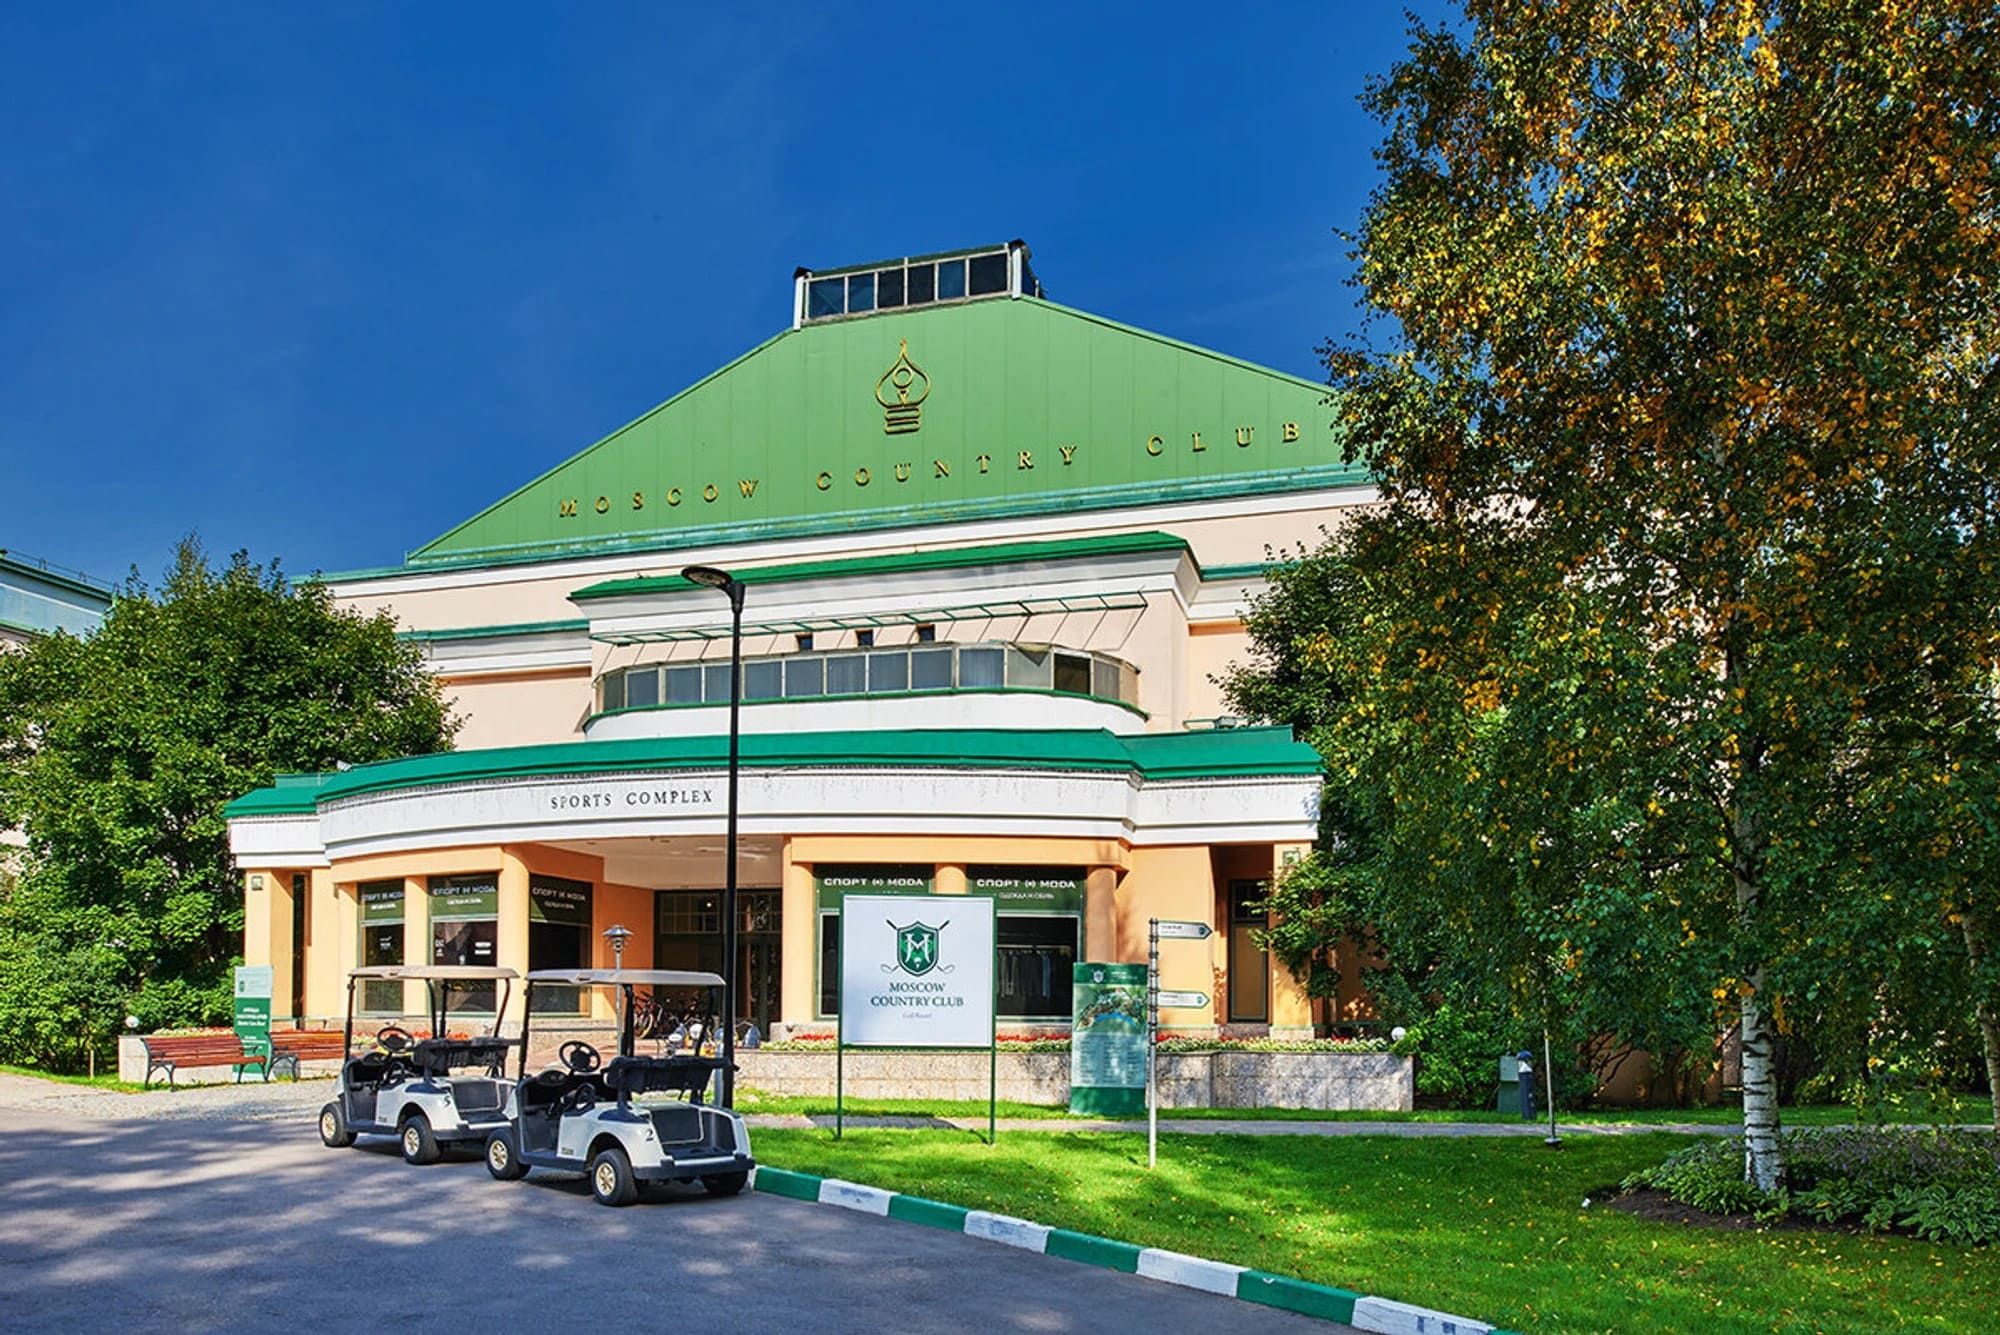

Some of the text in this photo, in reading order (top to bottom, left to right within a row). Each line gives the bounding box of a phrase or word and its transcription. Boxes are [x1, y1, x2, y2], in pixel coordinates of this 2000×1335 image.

[559, 422, 1300, 518] MOSCOW COUNTRY CLUB
[550, 790, 712, 809] SPORTS COMPLEX
[823, 878, 868, 886] СПОРТ
[976, 878, 1020, 887] СПОРТ
[889, 982, 946, 993] MOSCOW
[870, 996, 964, 1007] COUNTRY CLUB
[645, 1128, 654, 1141] 2
